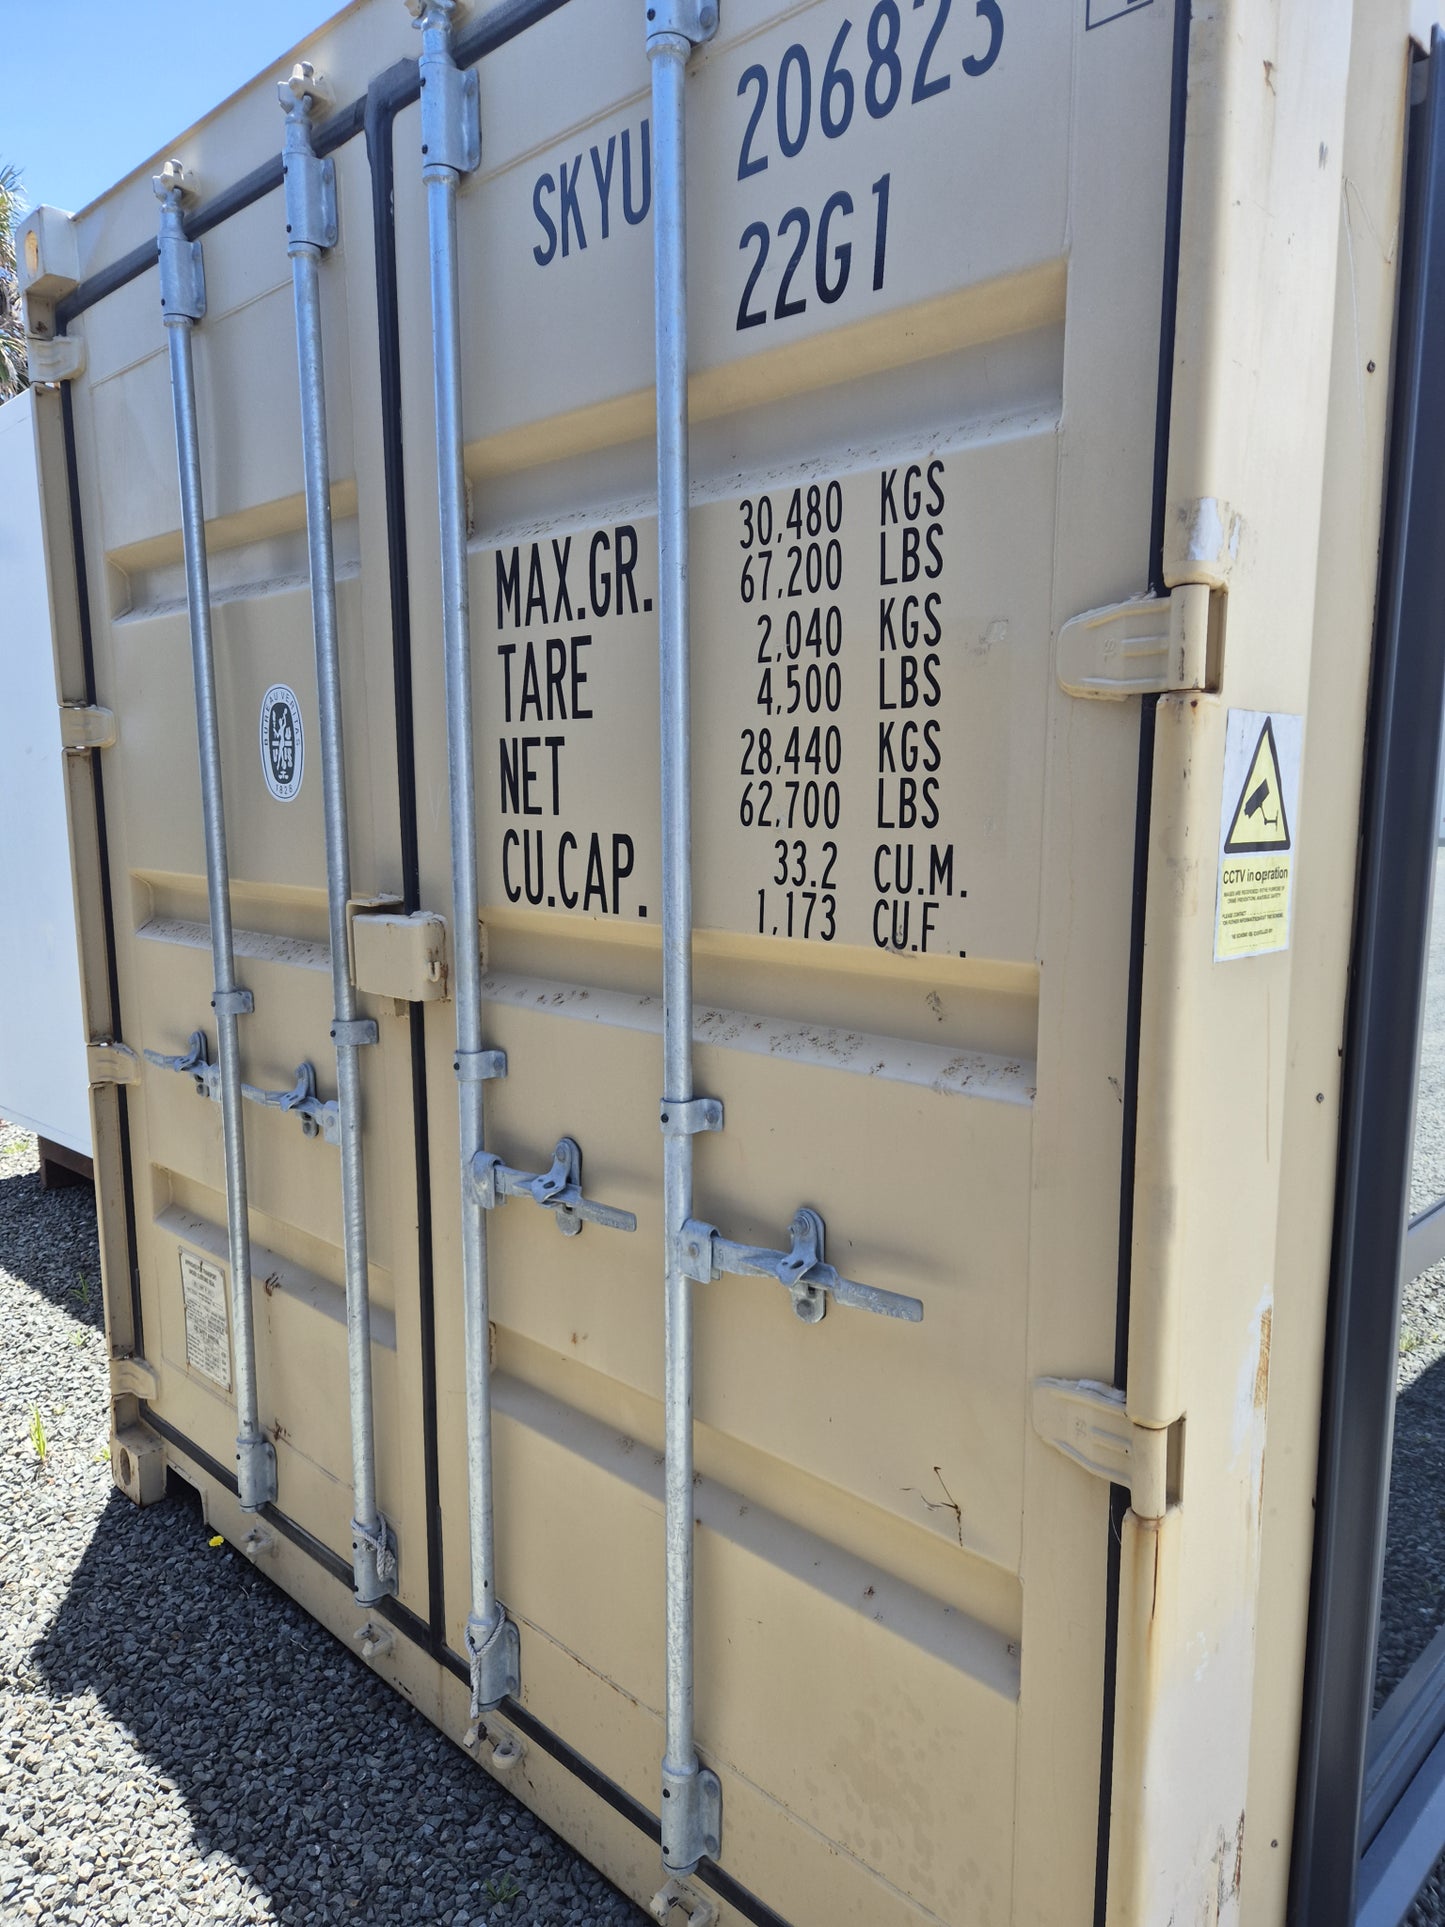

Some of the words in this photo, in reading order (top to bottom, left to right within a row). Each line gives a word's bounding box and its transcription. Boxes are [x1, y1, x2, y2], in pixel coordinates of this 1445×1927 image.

[532, 118, 653, 267] SKYU
[736, 0, 1005, 182] 206823
[735, 172, 891, 332] 22G1
[739, 480, 843, 550] 30,480
[880, 459, 945, 527] KGS
[495, 524, 653, 630] MAX.GR.
[740, 538, 843, 603] 67,200
[880, 522, 944, 586] LBS
[757, 605, 842, 664] 2,040
[880, 592, 942, 652] KGS
[497, 634, 593, 723] TARE
[757, 662, 842, 716] 4,500
[879, 653, 942, 710] LBS
[499, 736, 566, 816] NET
[740, 724, 842, 776] 28,440
[878, 719, 941, 773] KGS
[739, 780, 840, 830] 62,700
[877, 776, 940, 829] LBS
[502, 828, 647, 918] CU.CAP.
[773, 839, 838, 890] 33.2
[874, 843, 968, 898] CU.M.
[1223, 869, 1246, 885] CCTV
[1247, 868, 1254, 882] in
[758, 888, 836, 942] 1,173
